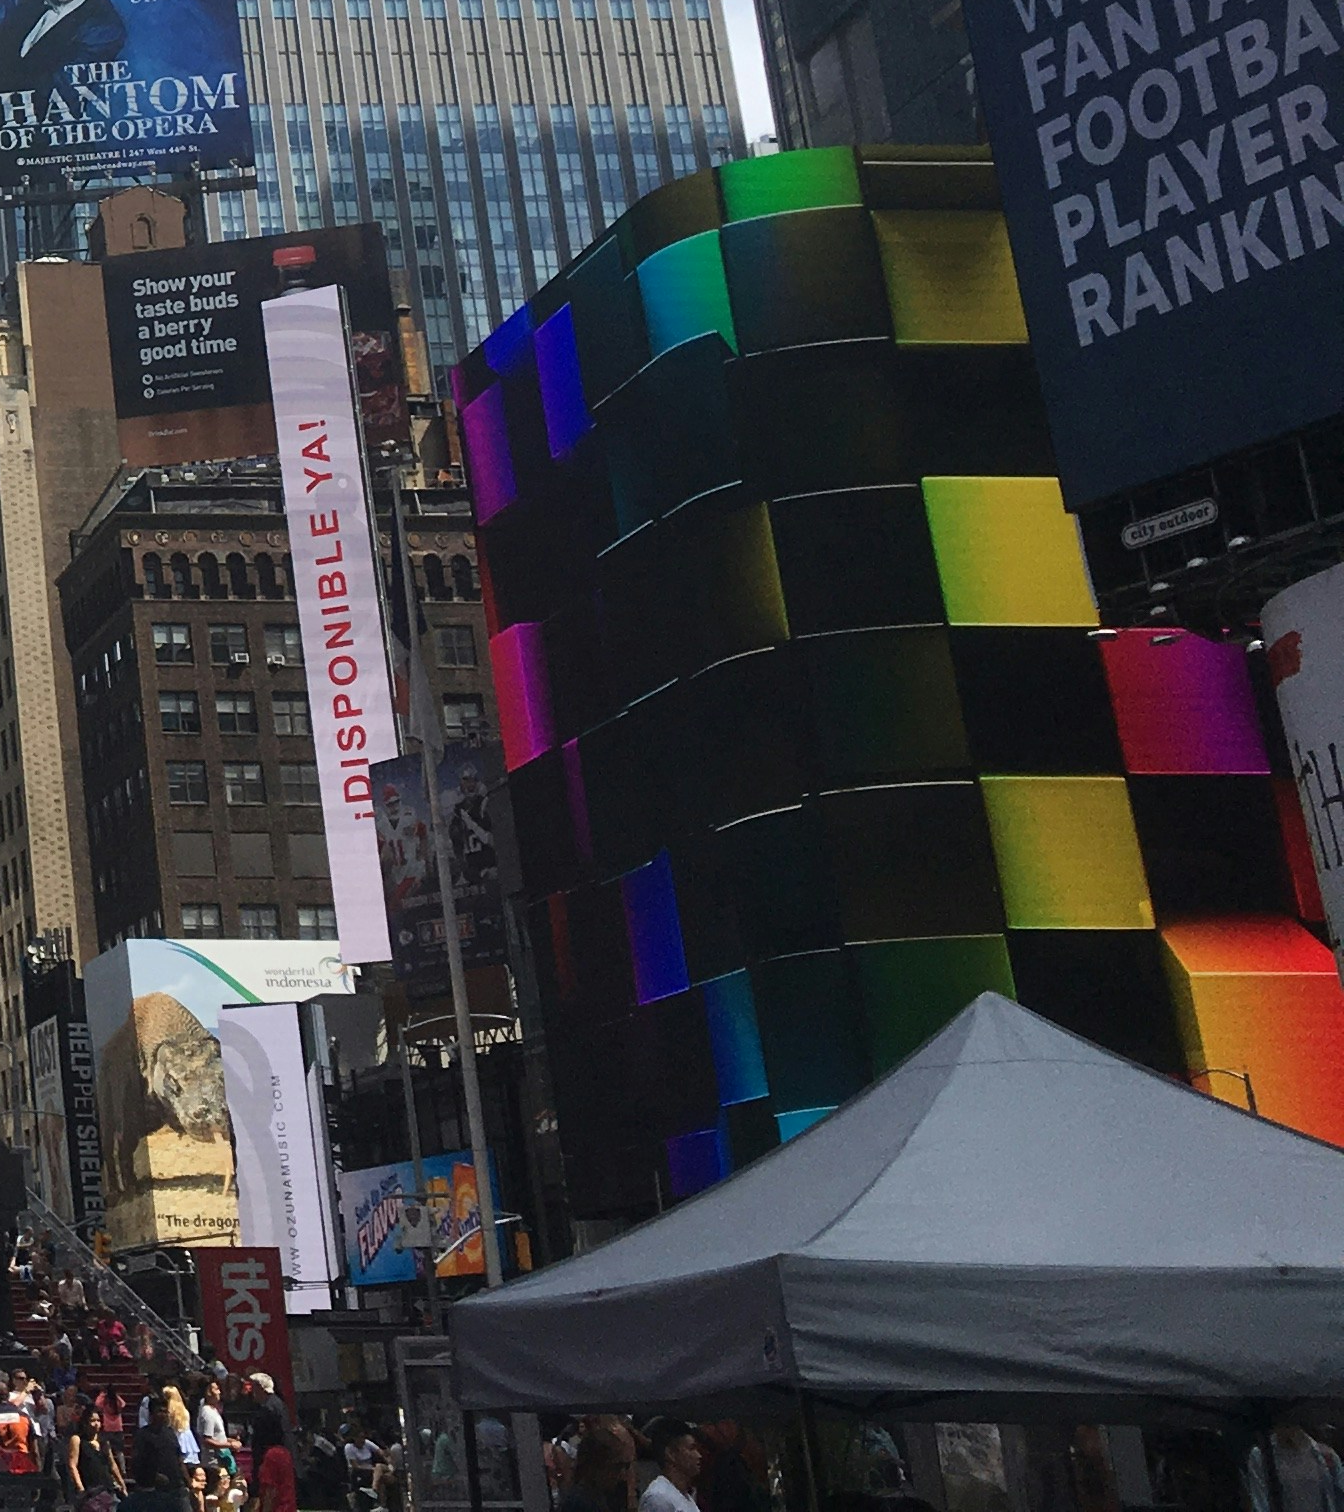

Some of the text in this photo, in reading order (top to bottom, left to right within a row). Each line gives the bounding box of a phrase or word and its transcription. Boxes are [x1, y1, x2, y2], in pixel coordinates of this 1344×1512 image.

[64, 60, 131, 86] THE
[41, 121, 107, 148] THE
[111, 112, 219, 141] OPERA
[26, 155, 73, 166] MAJESTIC
[75, 151, 121, 162] THEATRE
[1052, 82, 1338, 268] PLAYER
[132, 271, 237, 297] Show your
[135, 291, 239, 319] taste buds
[138, 317, 213, 339] a berry
[140, 337, 238, 365] good time
[298, 419, 333, 494] YA!
[1130, 503, 1211, 542] city outdoor
[264, 966, 316, 978] wonderful
[265, 976, 333, 989] indonesia
[67, 1022, 96, 1086] HELP
[73, 1082, 97, 1123] PET
[192, 1214, 241, 1231] dragon
[220, 1257, 272, 1361] tkts
